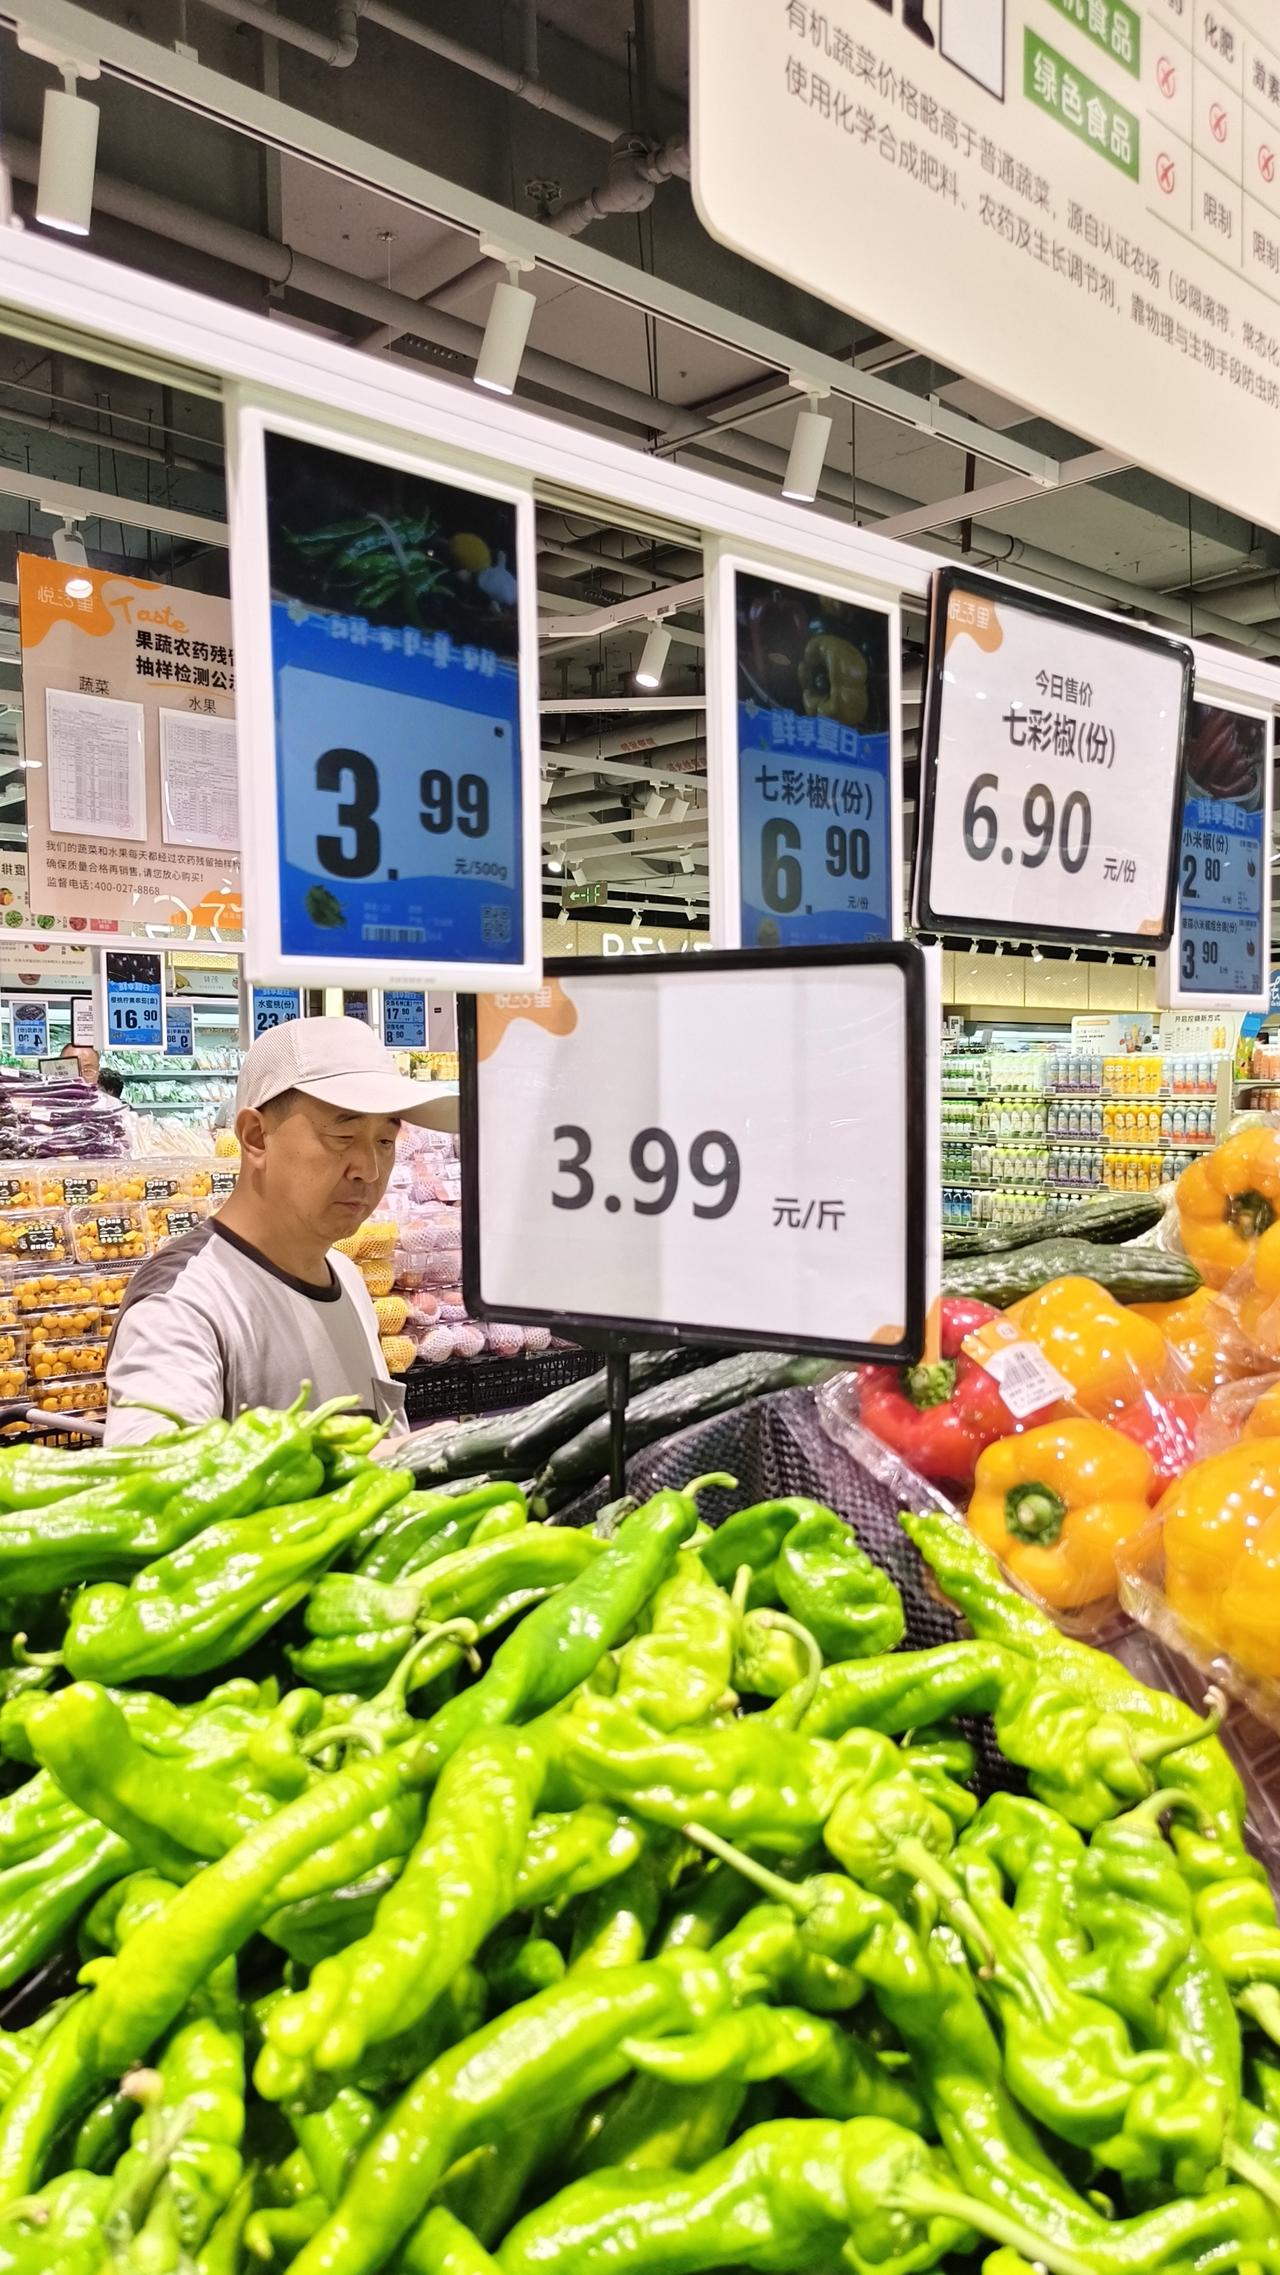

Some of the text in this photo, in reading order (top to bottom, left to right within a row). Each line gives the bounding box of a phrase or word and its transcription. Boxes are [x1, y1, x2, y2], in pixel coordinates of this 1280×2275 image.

[1203, 13, 1234, 64] 化肥
[1034, 50, 1132, 165] 绿色食品
[1203, 192, 1232, 240] 限制
[1252, 229, 1279, 275] 限制
[109, 596, 189, 635] Taste
[79, 675, 110, 695] 蔬菜
[188, 696, 217, 714] 水果
[1034, 669, 1094, 709] 今日售价
[1002, 706, 1116, 769] 七彩椒(份)
[754, 764, 873, 821] 七彩椒(份)
[962, 772, 1093, 875] 6.90
[1182, 831, 1240, 856] 小米椒(份)
[453, 856, 509, 882] 元/500g
[1102, 856, 1137, 883] 元/份
[551, 1124, 741, 1220] 3.99
[771, 1197, 847, 1232] 元/斤
